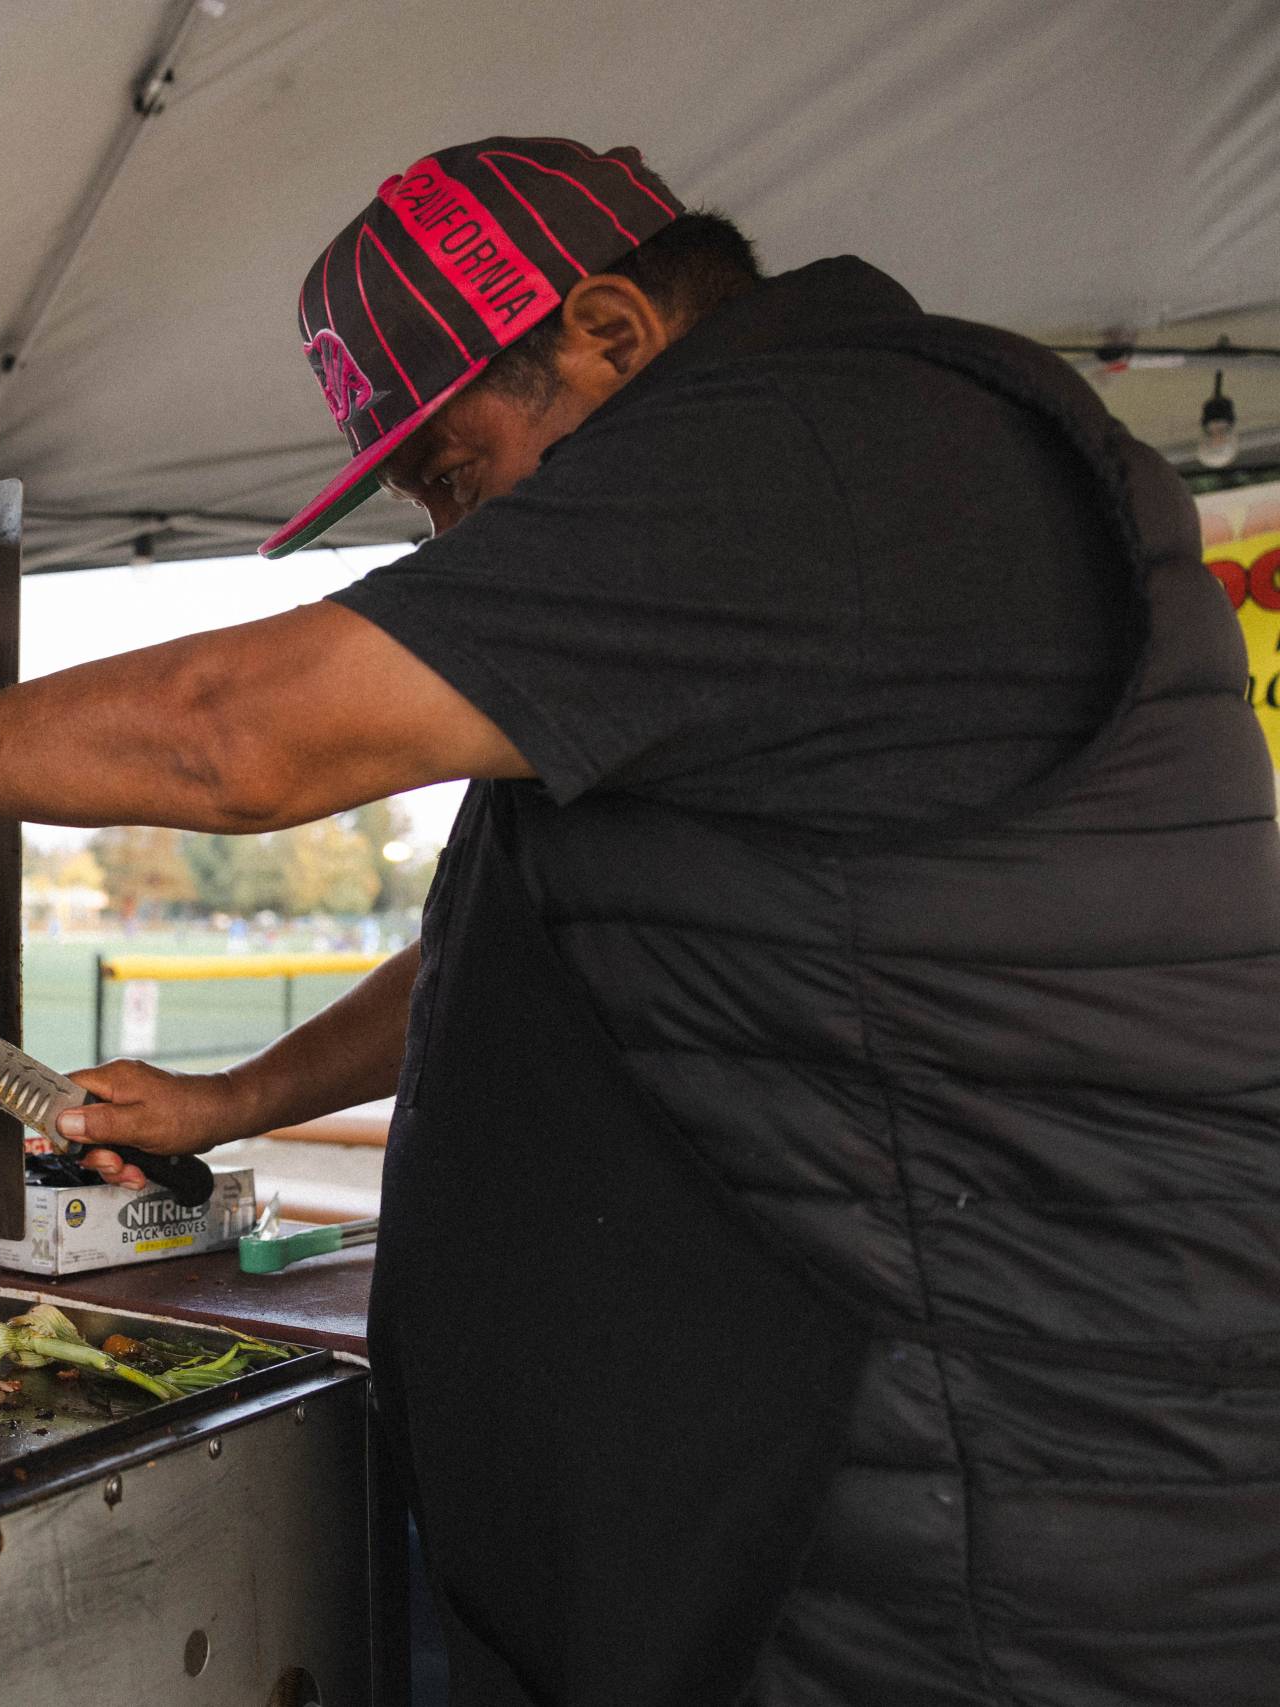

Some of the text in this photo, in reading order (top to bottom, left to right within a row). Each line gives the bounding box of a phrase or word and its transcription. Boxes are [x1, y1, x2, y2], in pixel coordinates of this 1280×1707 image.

[398, 174, 537, 324] CALIFORNIA
[127, 1200, 203, 1227] NITRILE
[122, 1221, 207, 1243] BLACK GLOVES
